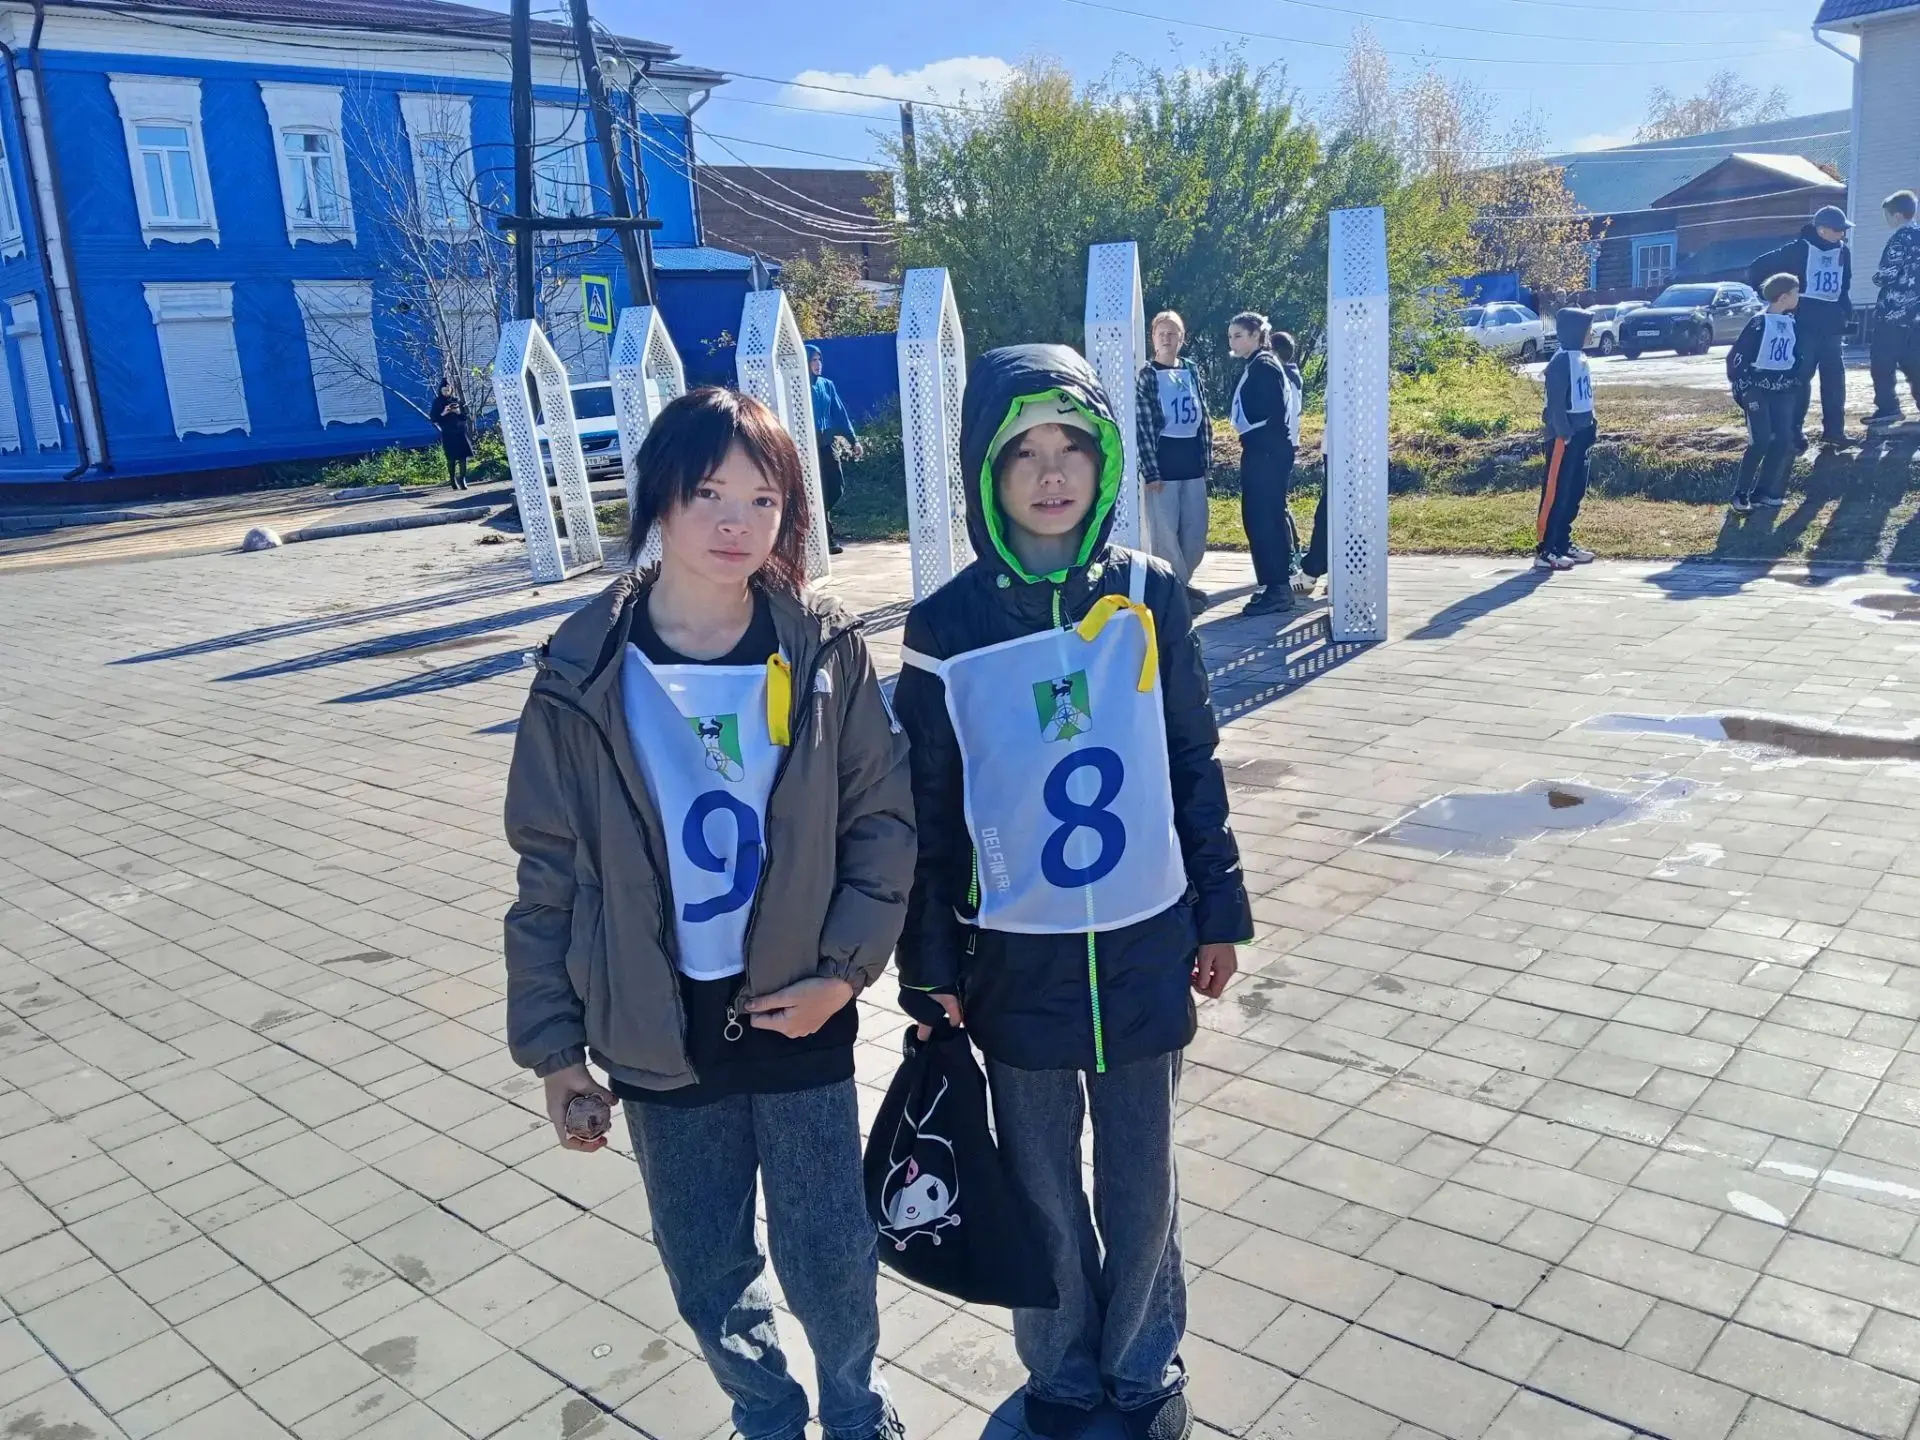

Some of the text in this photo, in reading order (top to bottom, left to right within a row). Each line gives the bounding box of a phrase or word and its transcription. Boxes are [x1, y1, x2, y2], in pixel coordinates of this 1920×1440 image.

[1814, 270, 1839, 293] 183
[1170, 396, 1198, 425] 155
[681, 789, 761, 923] 9
[1040, 746, 1127, 889] 8
